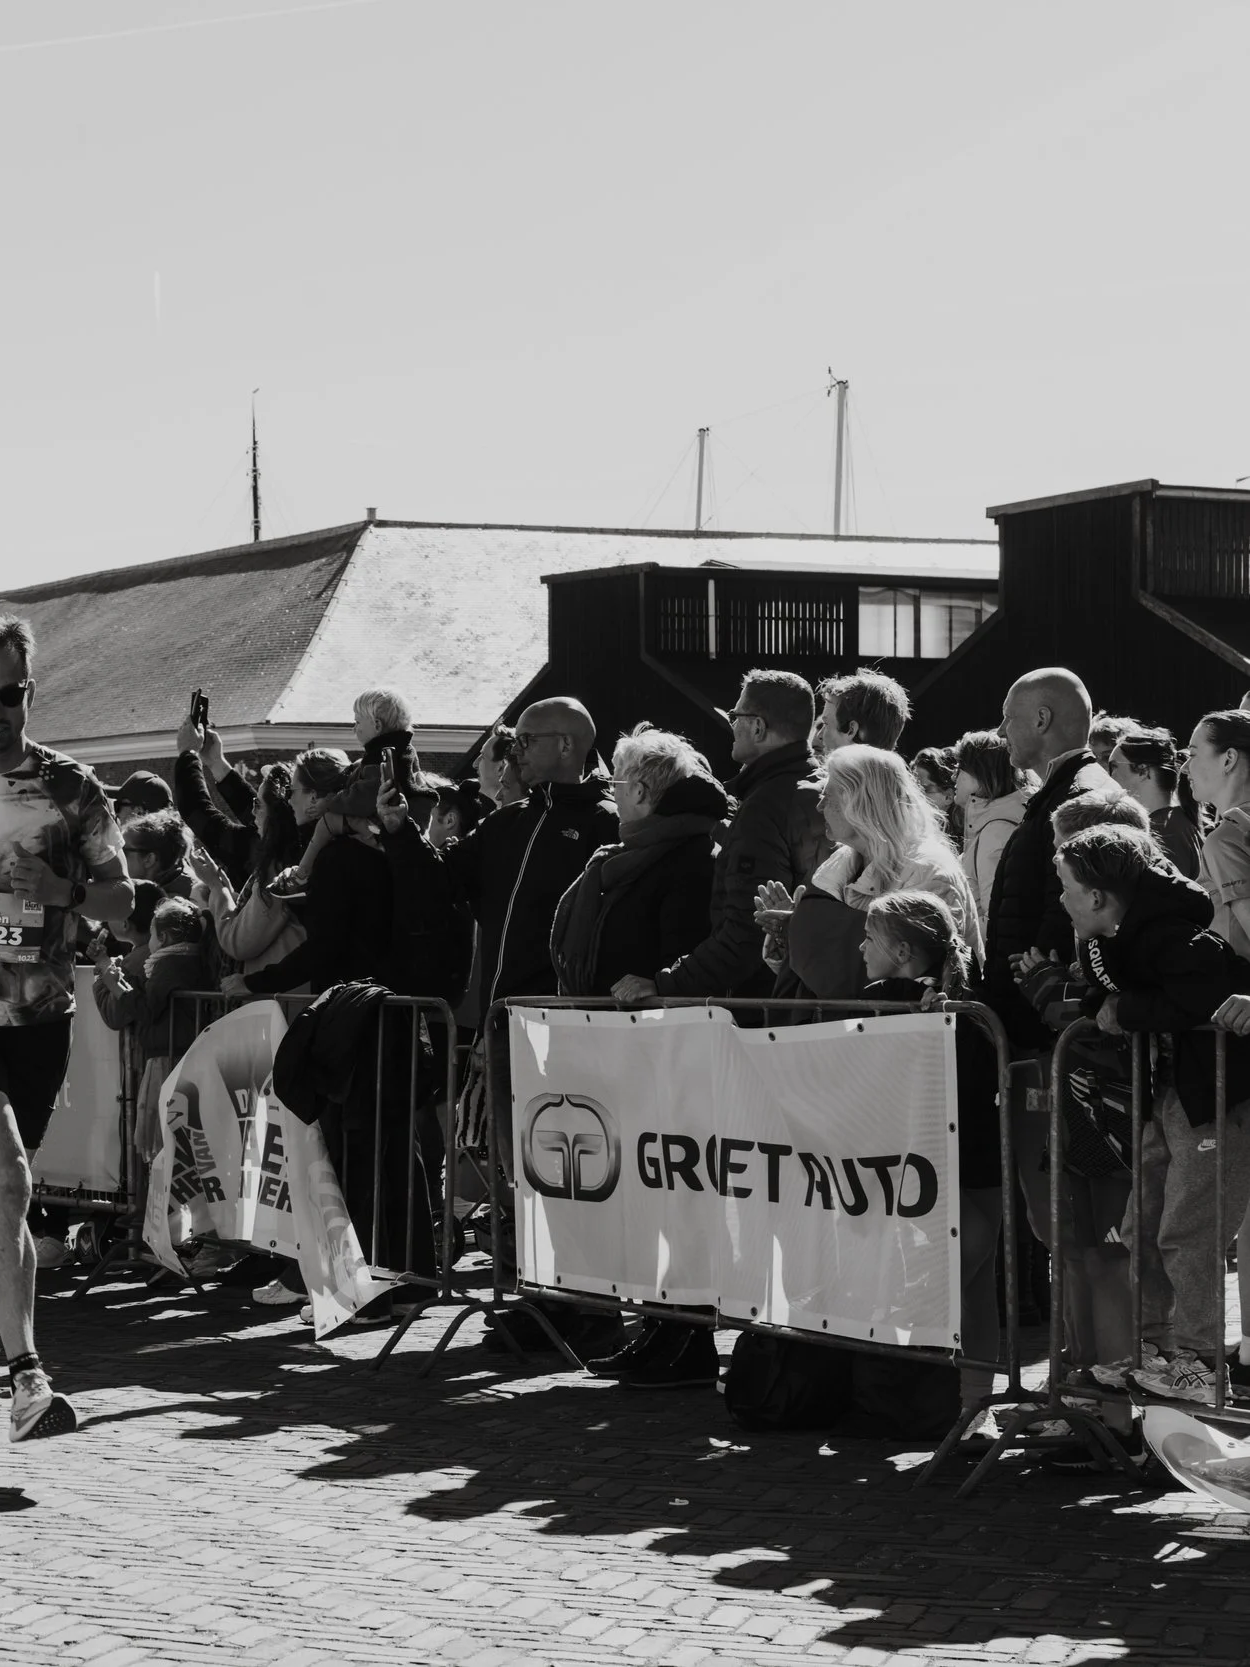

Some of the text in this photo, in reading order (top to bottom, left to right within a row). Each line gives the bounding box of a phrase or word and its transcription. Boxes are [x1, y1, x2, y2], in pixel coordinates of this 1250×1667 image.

[18, 954, 36, 962] 1023
[1088, 937, 1121, 993] SQUARE
[797, 1152, 940, 1219] AUTO
